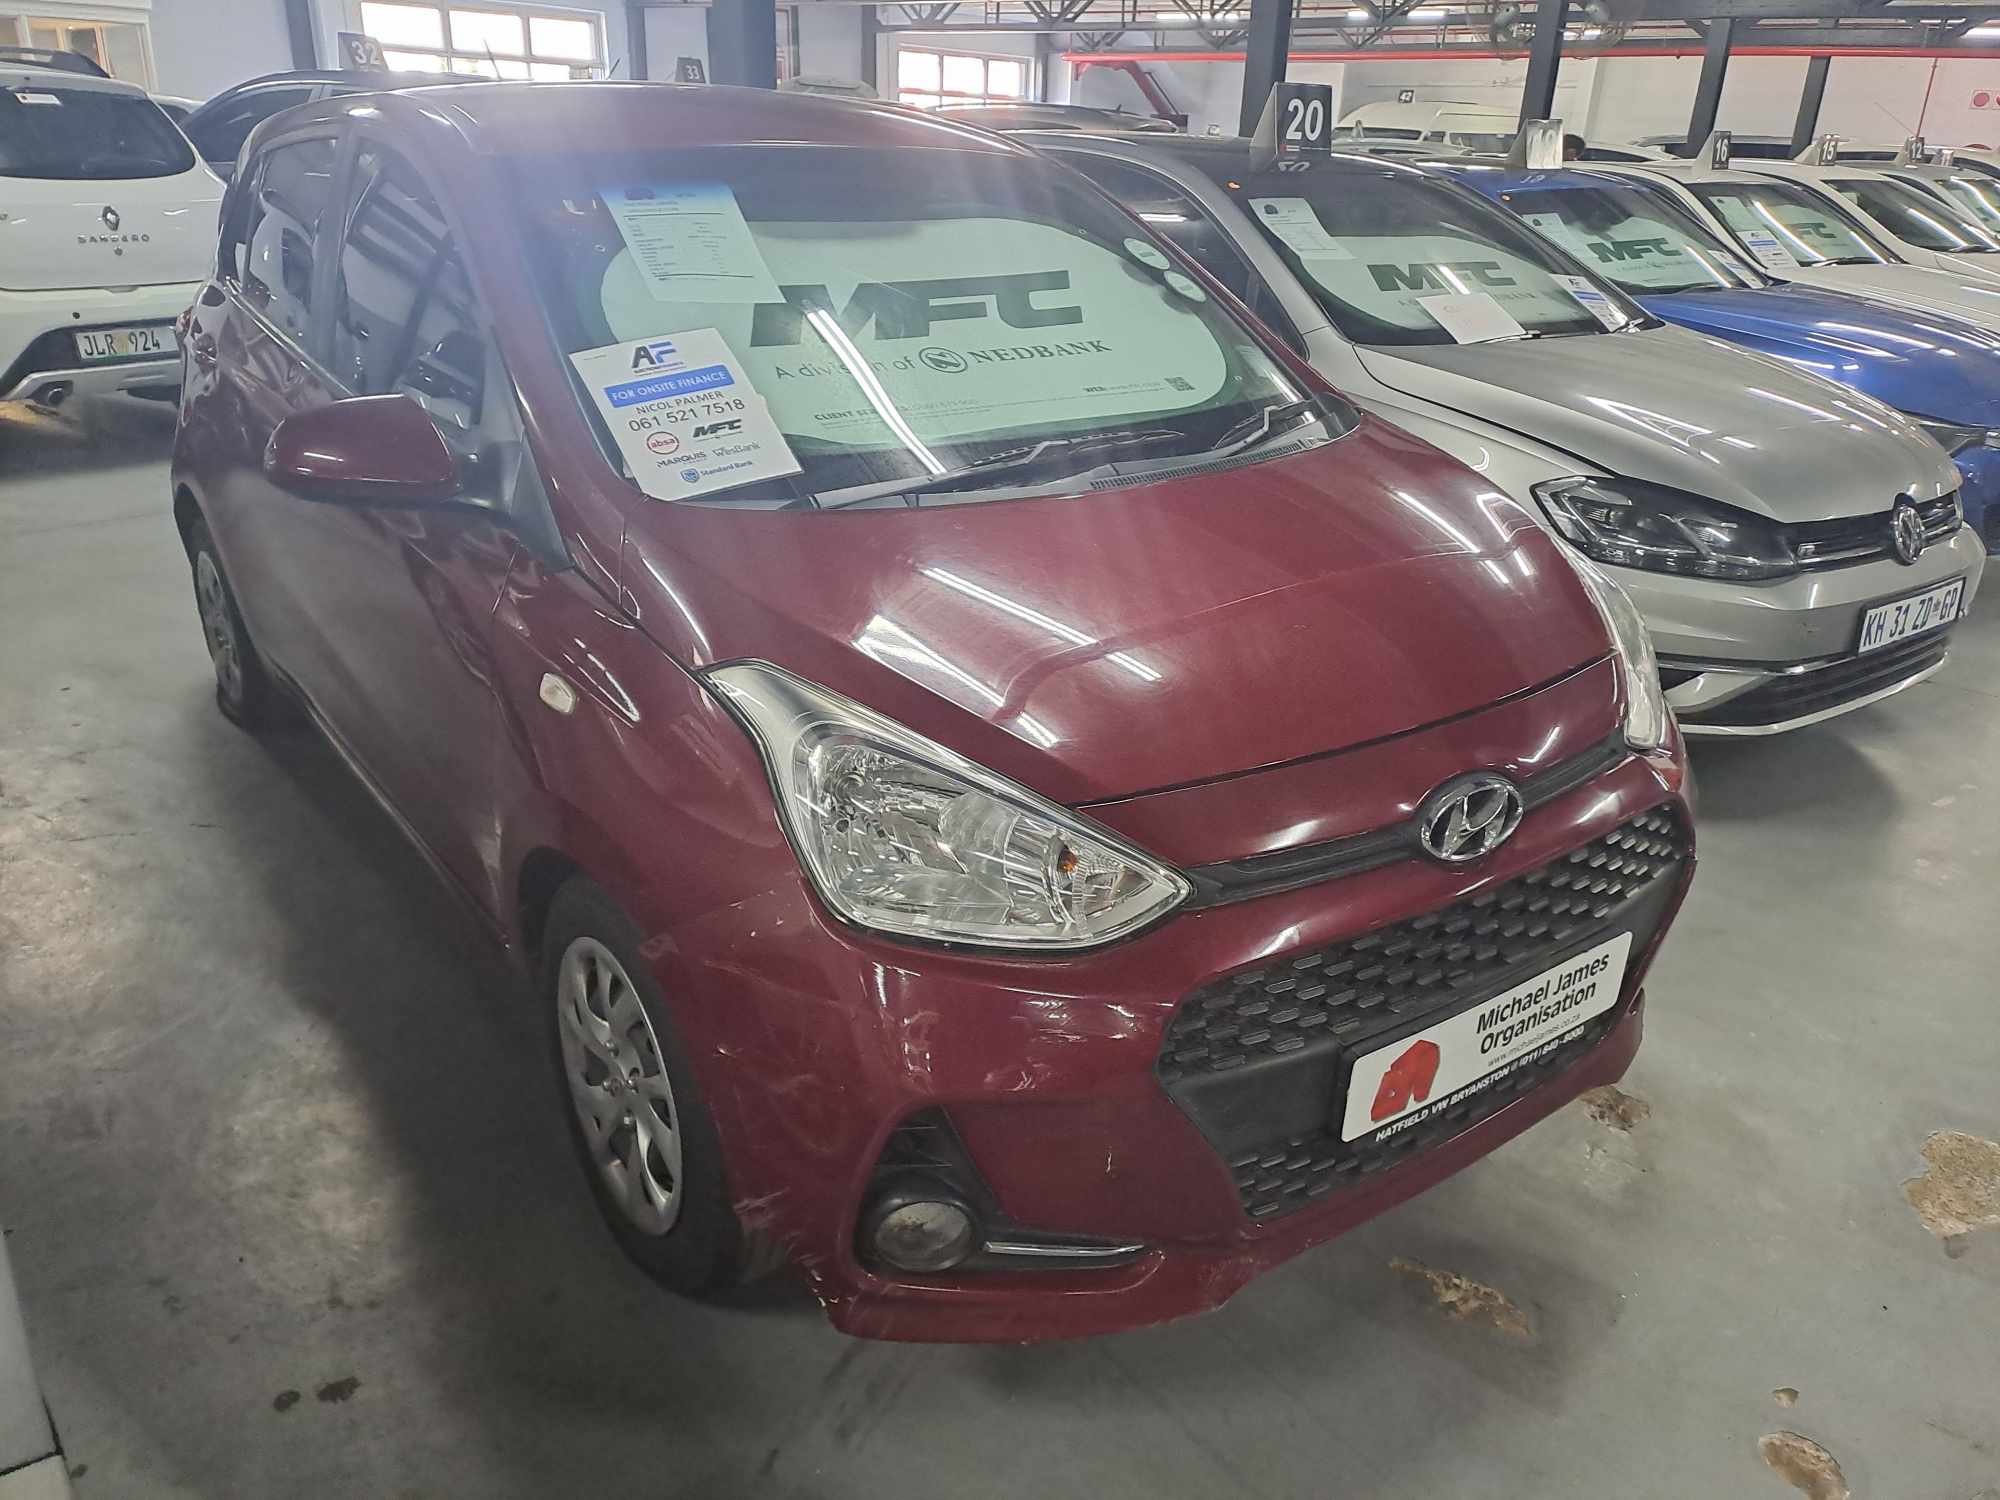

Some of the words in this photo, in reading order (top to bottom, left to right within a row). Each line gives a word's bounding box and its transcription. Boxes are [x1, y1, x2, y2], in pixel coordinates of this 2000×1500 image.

[352, 40, 382, 65] 32
[685, 64, 700, 80] 33
[1286, 98, 1323, 141] 20
[1714, 138, 1729, 162] 16
[1822, 140, 1835, 161] 15
[1911, 142, 1923, 159] 12
[1588, 236, 1682, 263] MFC
[1367, 261, 1517, 292] MFC
[750, 270, 1083, 348] MFC
[84, 334, 117, 357] JLR
[128, 331, 161, 353] 924
[775, 366, 795, 379] A
[892, 356, 916, 370] of
[967, 340, 1113, 364] NEDBANK
[612, 389, 635, 401] FOR
[637, 381, 677, 396] ONSITE
[677, 371, 727, 389] FINANCE
[628, 416, 662, 432] 061
[666, 407, 699, 424] 521
[702, 398, 745, 417] 7518
[635, 401, 674, 415] NICOL
[675, 390, 726, 407] PALMER
[693, 418, 743, 438] MFC
[656, 451, 707, 469] MARQUIS
[1863, 610, 1887, 647] KH
[1889, 603, 1911, 638] 31
[1912, 597, 1934, 631] ZD
[1939, 587, 1958, 621] GP
[1476, 979, 1551, 1034] Michael
[1553, 954, 1609, 996] James
[1375, 1108, 1429, 1142] HATFIELD
[1431, 1098, 1450, 1115] VW
[1450, 1064, 1510, 1106] BRYANSTON
